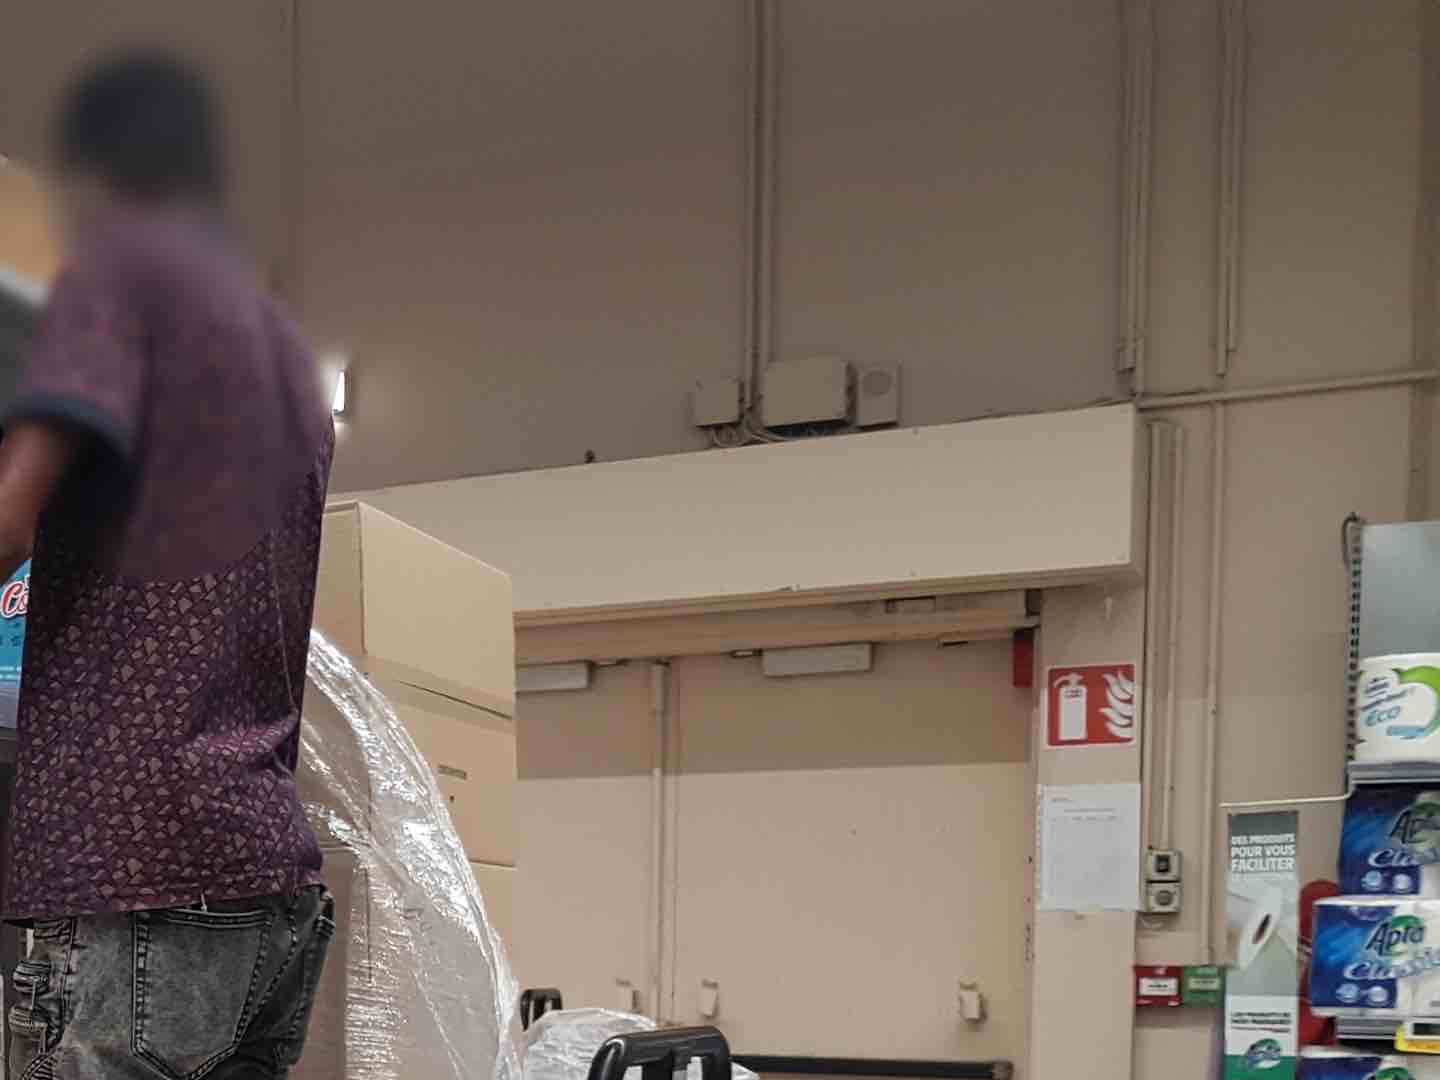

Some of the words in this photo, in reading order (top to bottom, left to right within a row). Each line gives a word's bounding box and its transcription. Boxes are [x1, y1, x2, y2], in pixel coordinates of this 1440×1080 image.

[1232, 846, 1262, 857] POUR
[1264, 845, 1296, 856] VOUS
[1232, 857, 1295, 871] FACILITER
